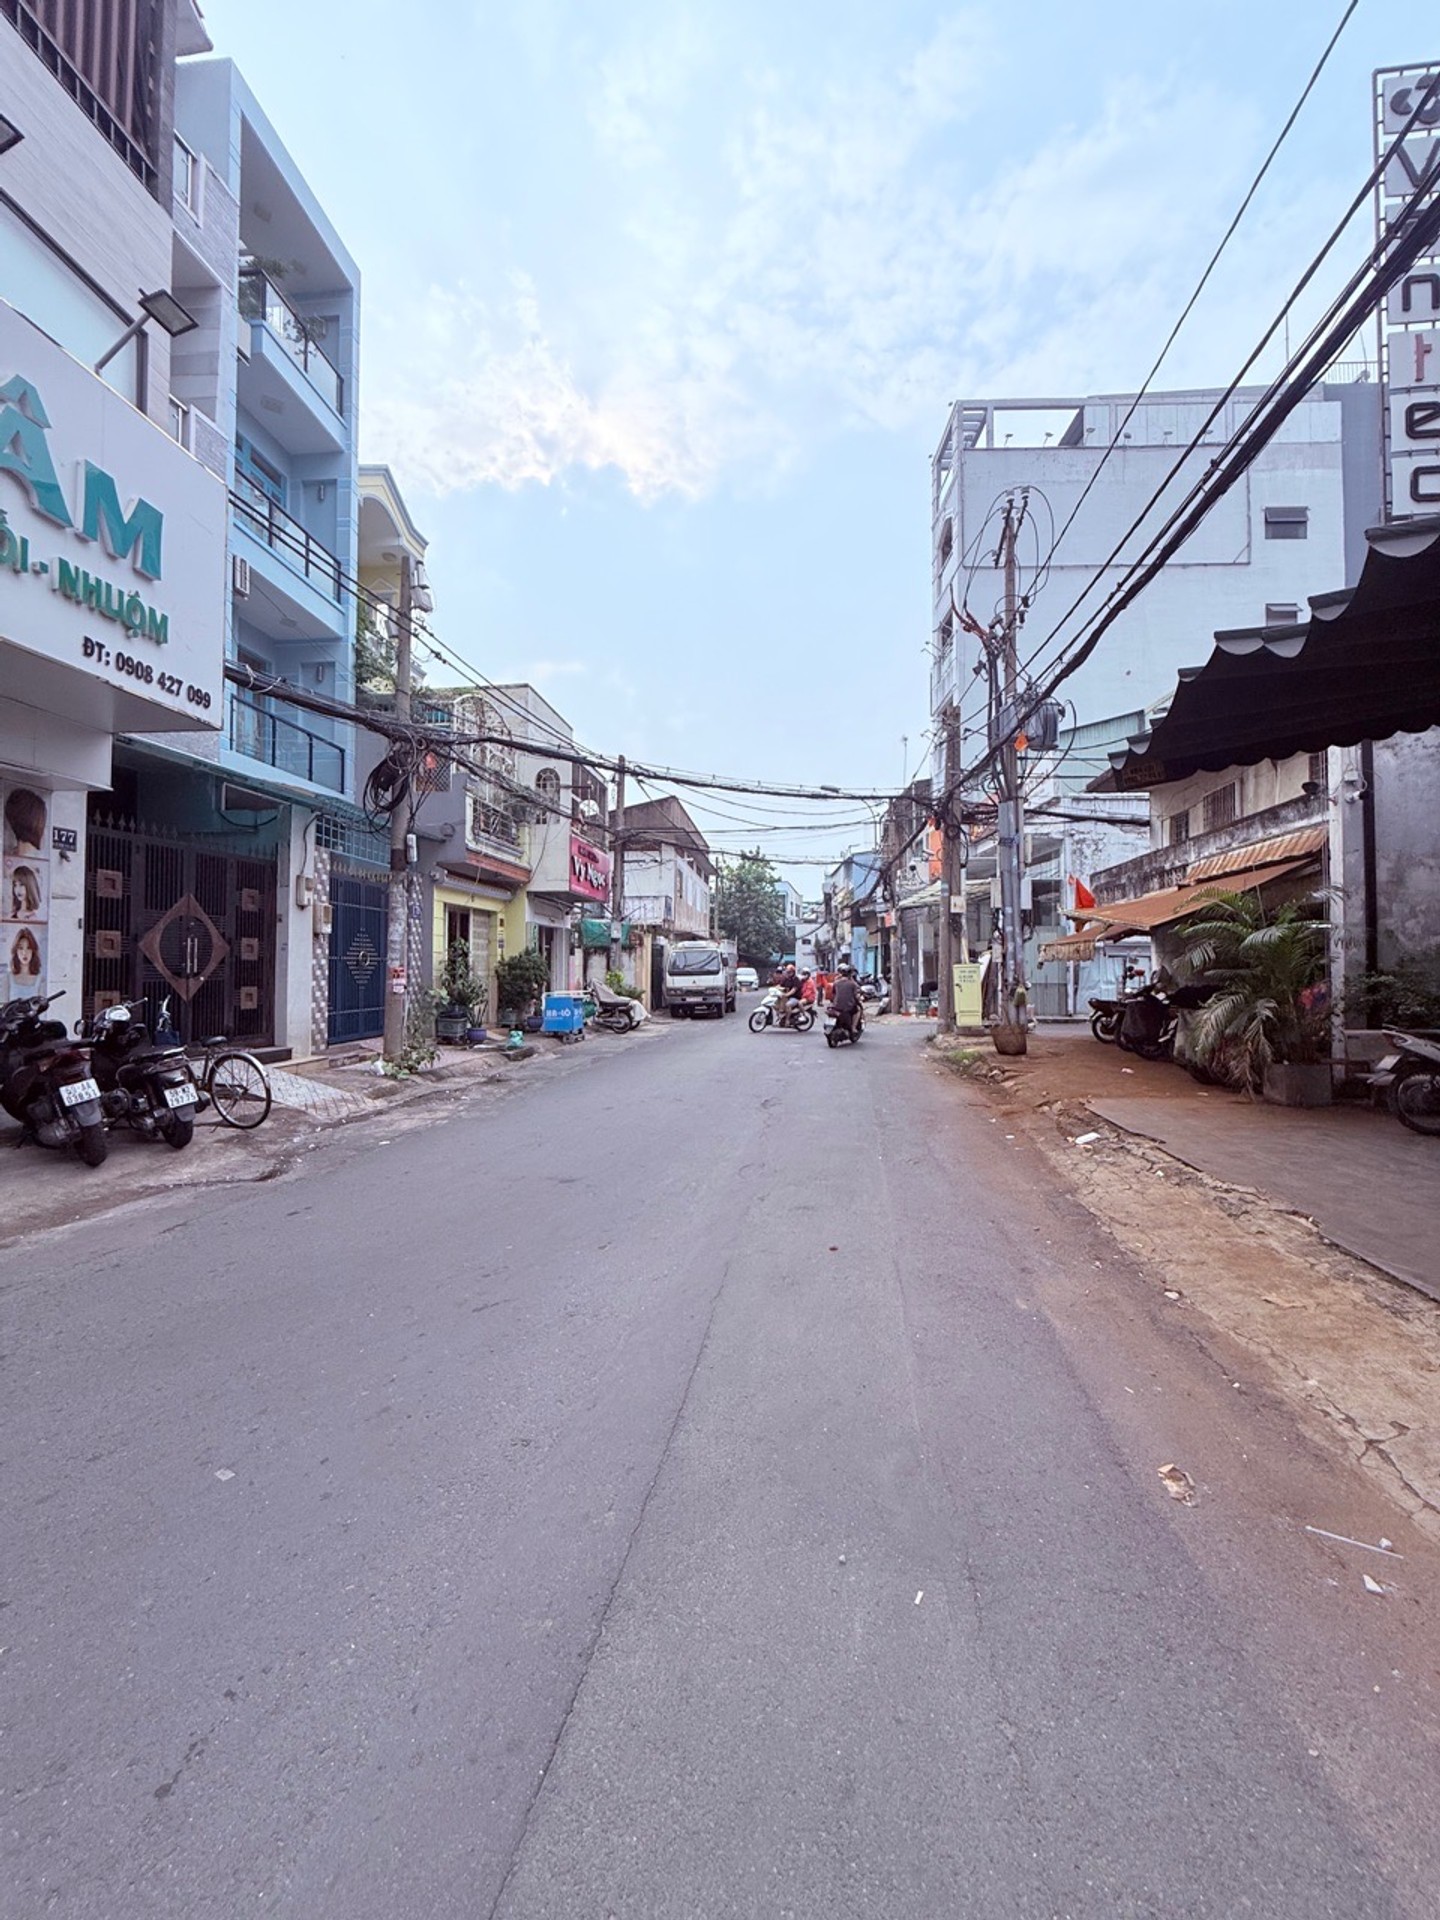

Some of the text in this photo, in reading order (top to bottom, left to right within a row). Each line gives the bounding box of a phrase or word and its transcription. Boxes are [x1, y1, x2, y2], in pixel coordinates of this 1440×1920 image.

[52, 556, 169, 645] NHUỘM
[82, 635, 212, 709] ĐT: 0908 427 099
[54, 830, 75, 843] 177
